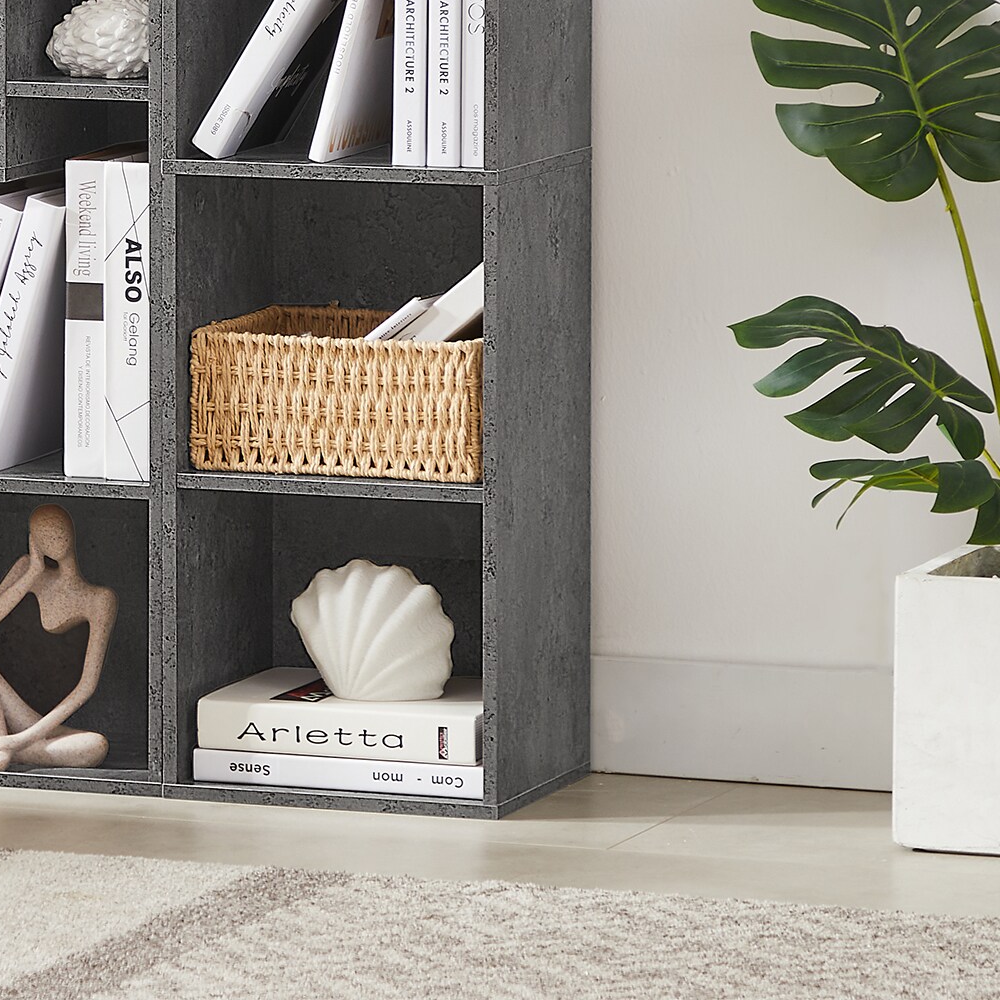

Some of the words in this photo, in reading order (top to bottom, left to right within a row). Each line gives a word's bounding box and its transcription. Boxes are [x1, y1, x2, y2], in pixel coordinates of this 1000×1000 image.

[405, 0, 416, 81] ARCHITECTURE
[439, 0, 450, 83] ARCHITECTURE
[404, 86, 415, 94] 2
[438, 88, 450, 96] 2
[217, 104, 231, 124] ISSUE
[405, 119, 413, 153] ASSOULINE
[440, 121, 448, 154] ASSOULINE
[471, 119, 479, 157] magazine
[78, 180, 97, 237] Weekend
[72, 241, 97, 277] living
[124, 238, 143, 303] ALSO
[125, 312, 141, 366] Gelang
[236, 722, 404, 749] Arletta
[229, 762, 271, 776] Sense
[372, 771, 404, 783] mon
[430, 775, 465, 788] Com
